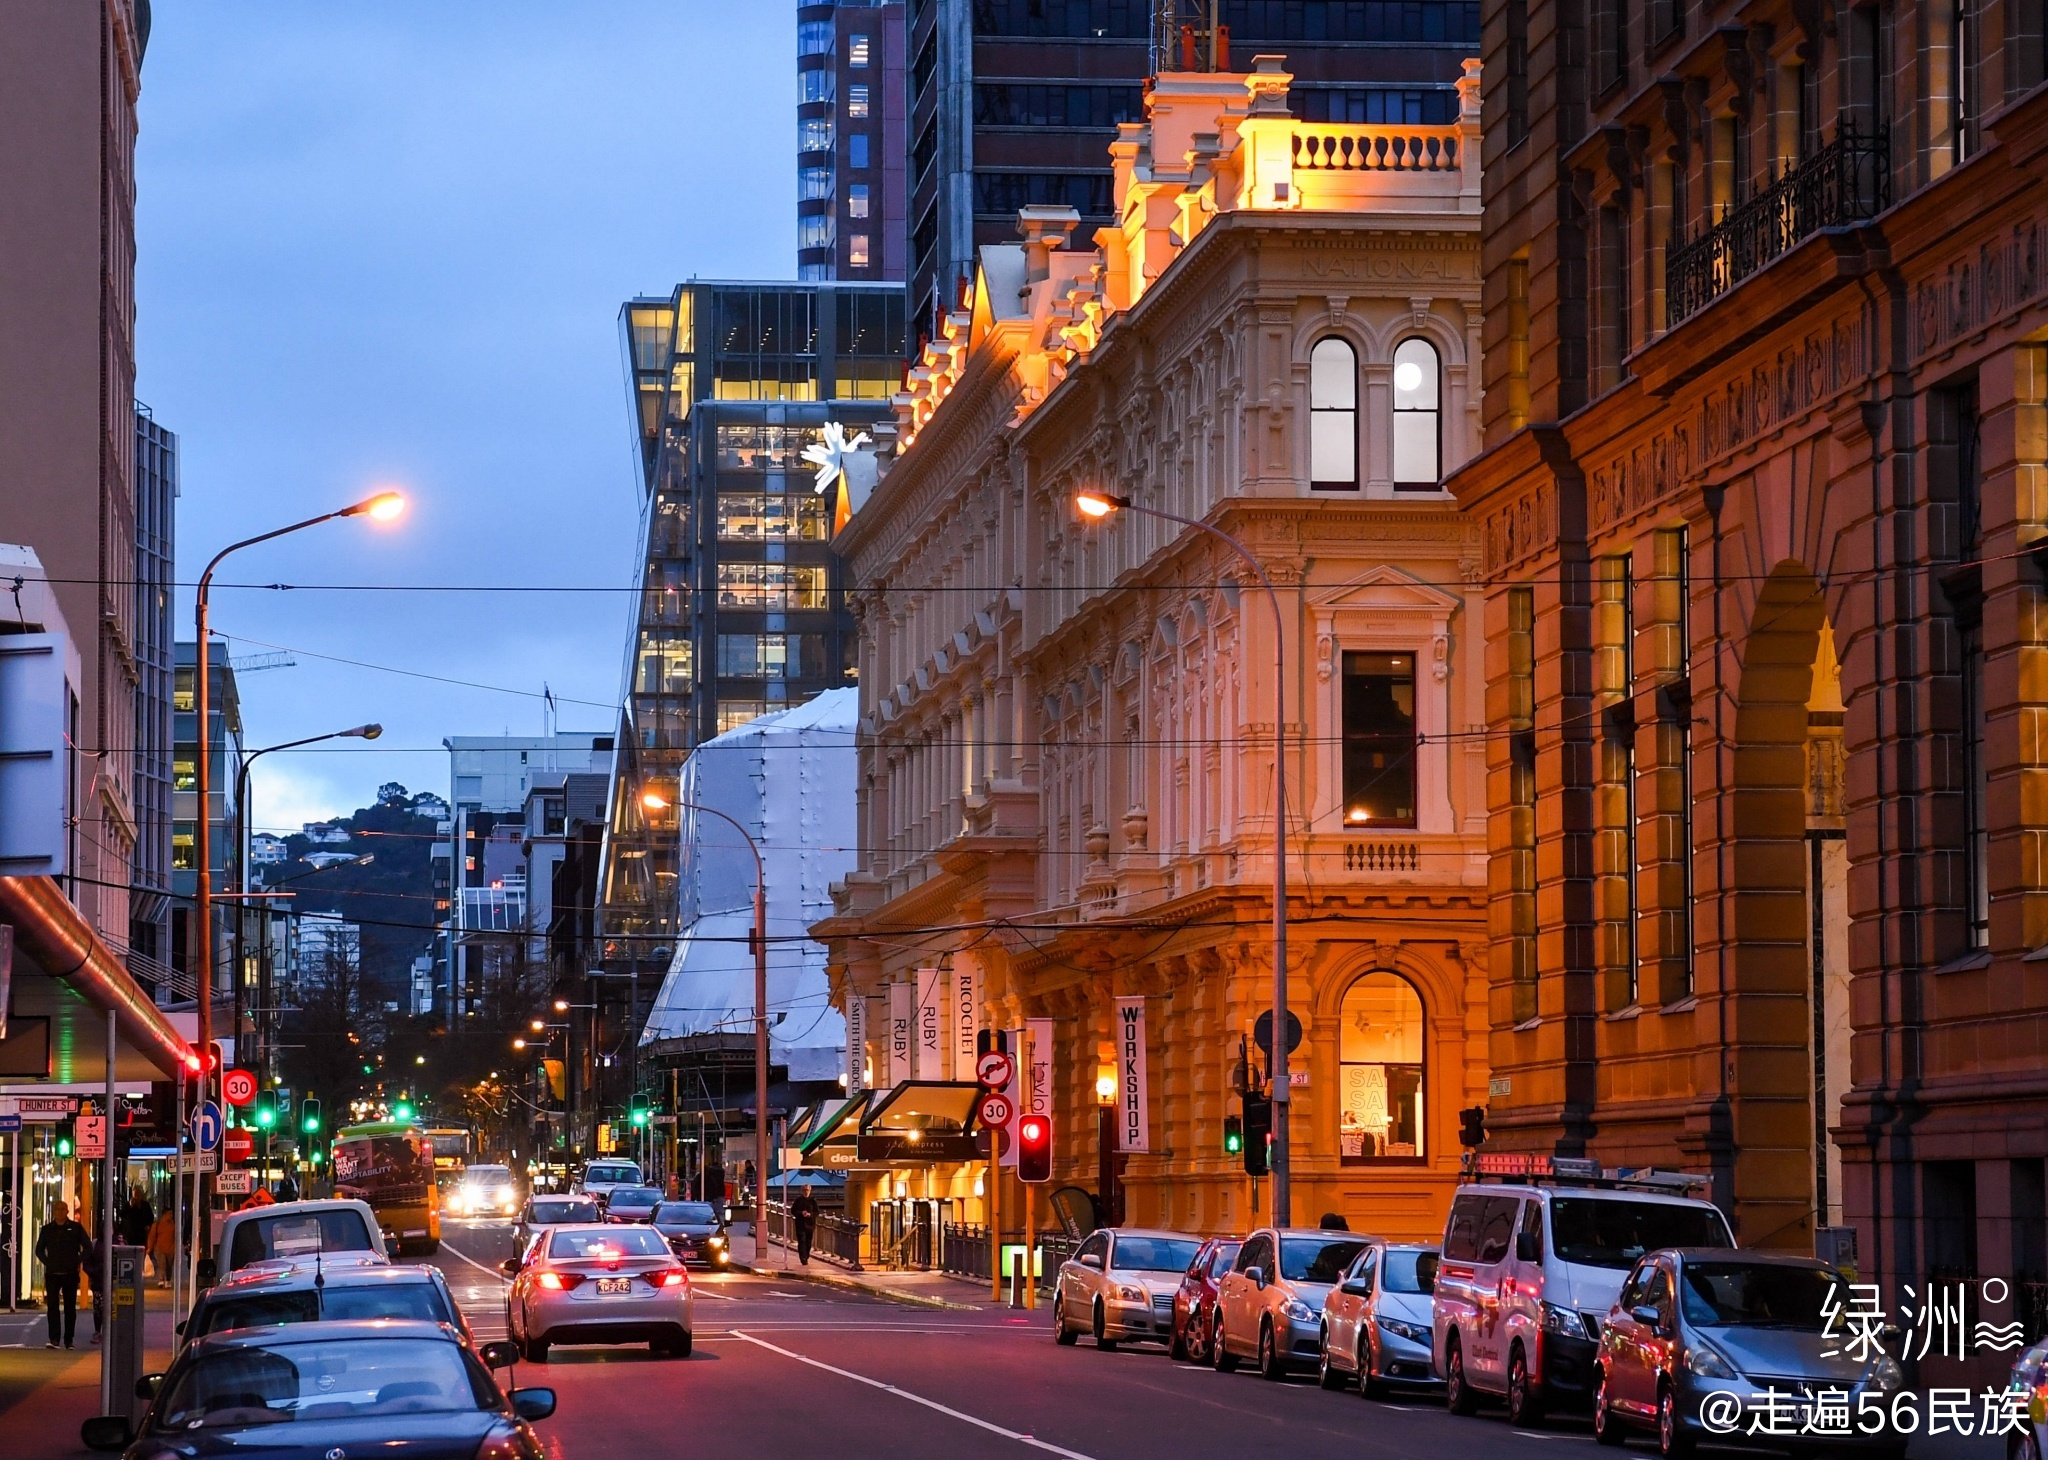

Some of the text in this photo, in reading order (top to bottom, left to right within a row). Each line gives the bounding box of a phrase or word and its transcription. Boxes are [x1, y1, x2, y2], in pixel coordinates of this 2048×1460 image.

[1301, 256, 1461, 280] NATIONAL
[960, 975, 973, 1057] RICOCHET
[923, 1006, 936, 1050] RUBY
[894, 1019, 906, 1061] RUBY
[851, 1002, 860, 1095] SMITH THE GROCE
[1122, 1007, 1139, 1145] WORKSHOP
[1296, 1074, 1306, 1083] ST
[230, 1081, 249, 1094] 30
[25, 1100, 71, 1110] HUNTER ST
[985, 1104, 1006, 1118] 30
[911, 1141, 944, 1150] express
[335, 1156, 348, 1164] WE
[335, 1160, 359, 1170] WANT
[219, 1173, 246, 1181] EXCEPT
[336, 1165, 392, 1183] ADAPTABILITY
[120, 1260, 134, 1278] P
[598, 1283, 630, 1292] KCF242
